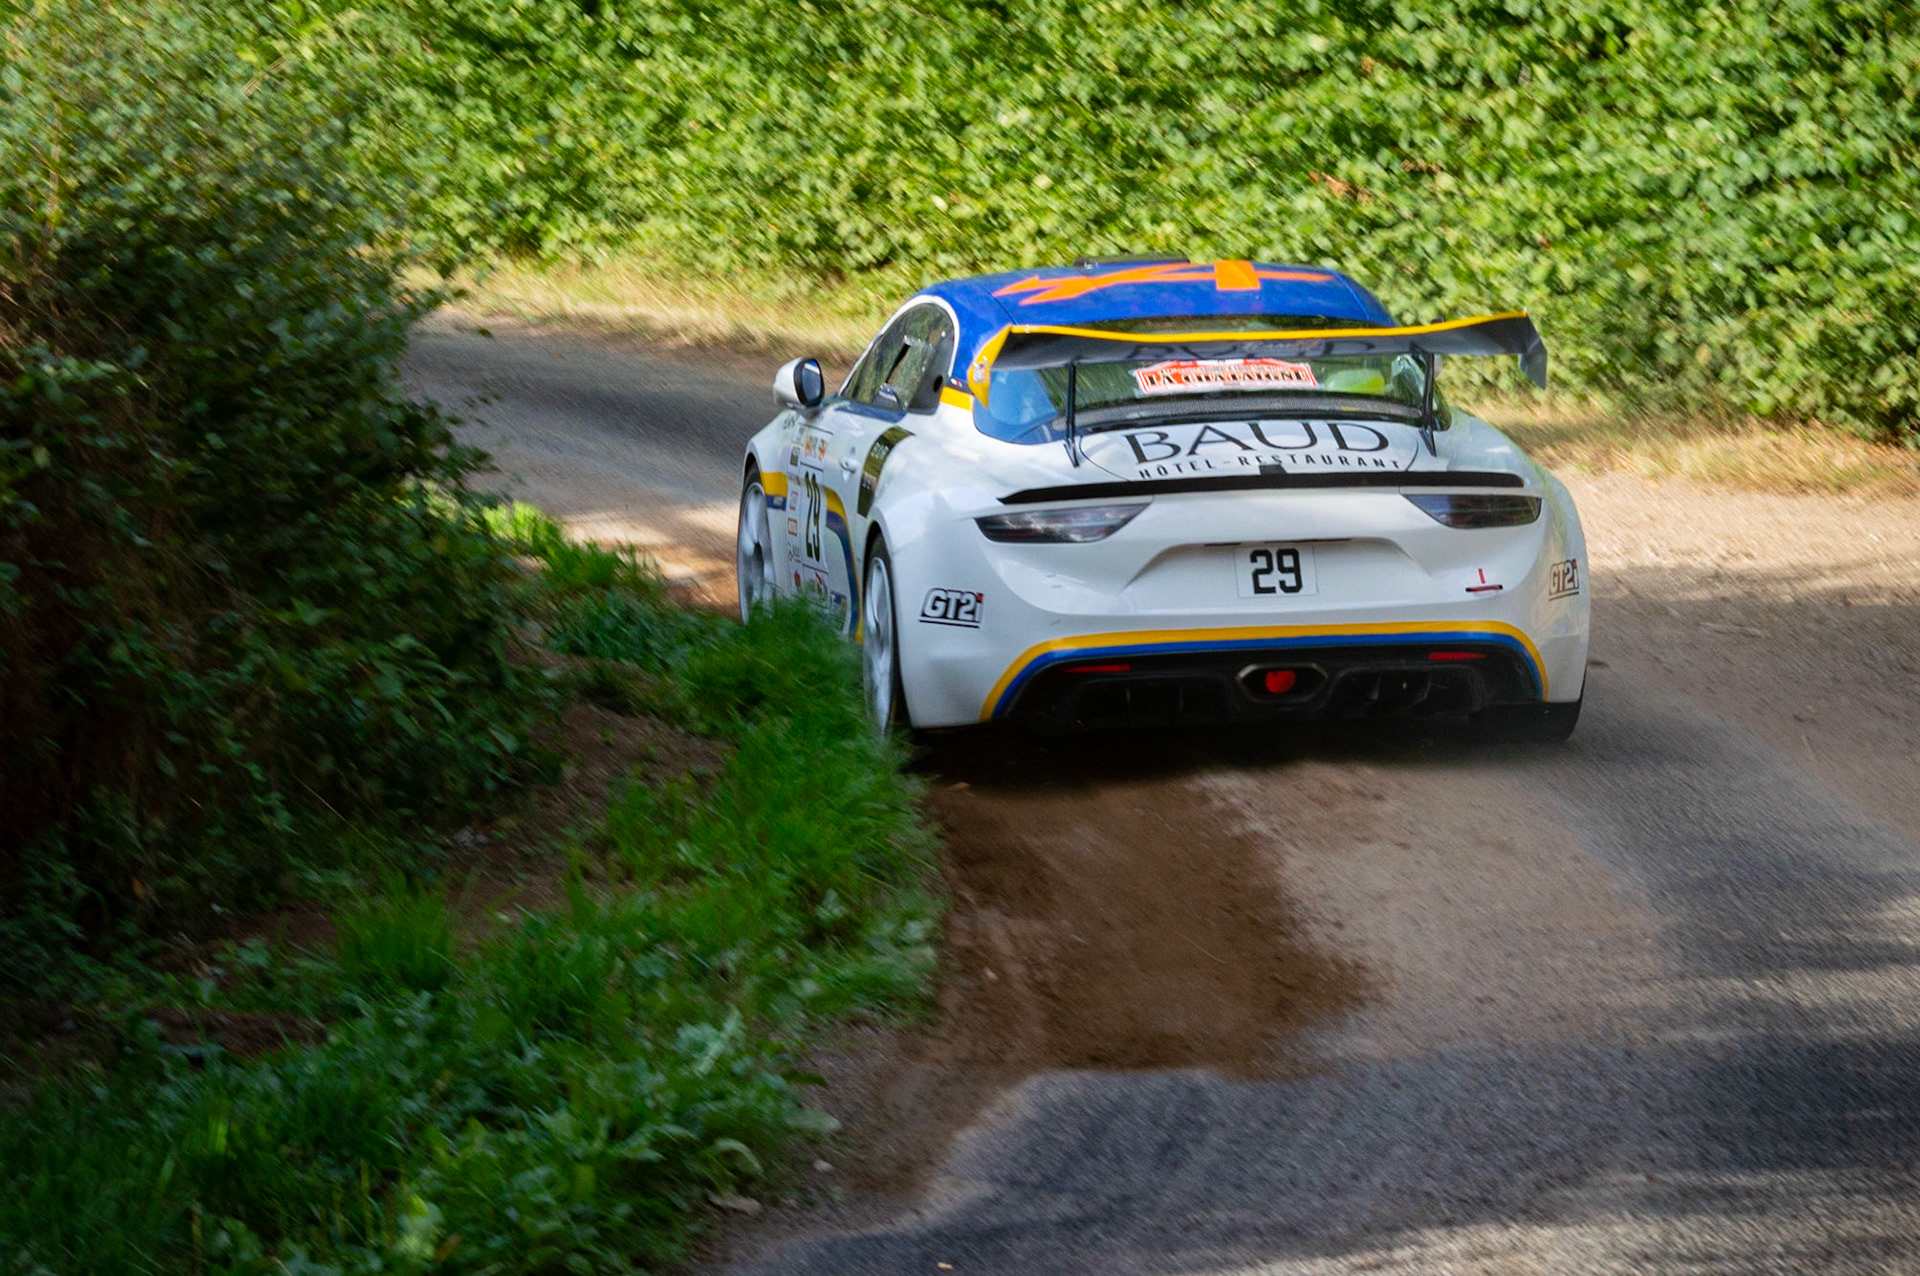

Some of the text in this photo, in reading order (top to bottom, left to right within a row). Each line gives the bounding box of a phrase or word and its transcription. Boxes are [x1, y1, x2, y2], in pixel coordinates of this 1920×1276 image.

[1123, 422, 1389, 464] BAUD
[805, 471, 820, 562] 29
[1250, 547, 1303, 594] 29
[921, 588, 984, 623] GT2i
